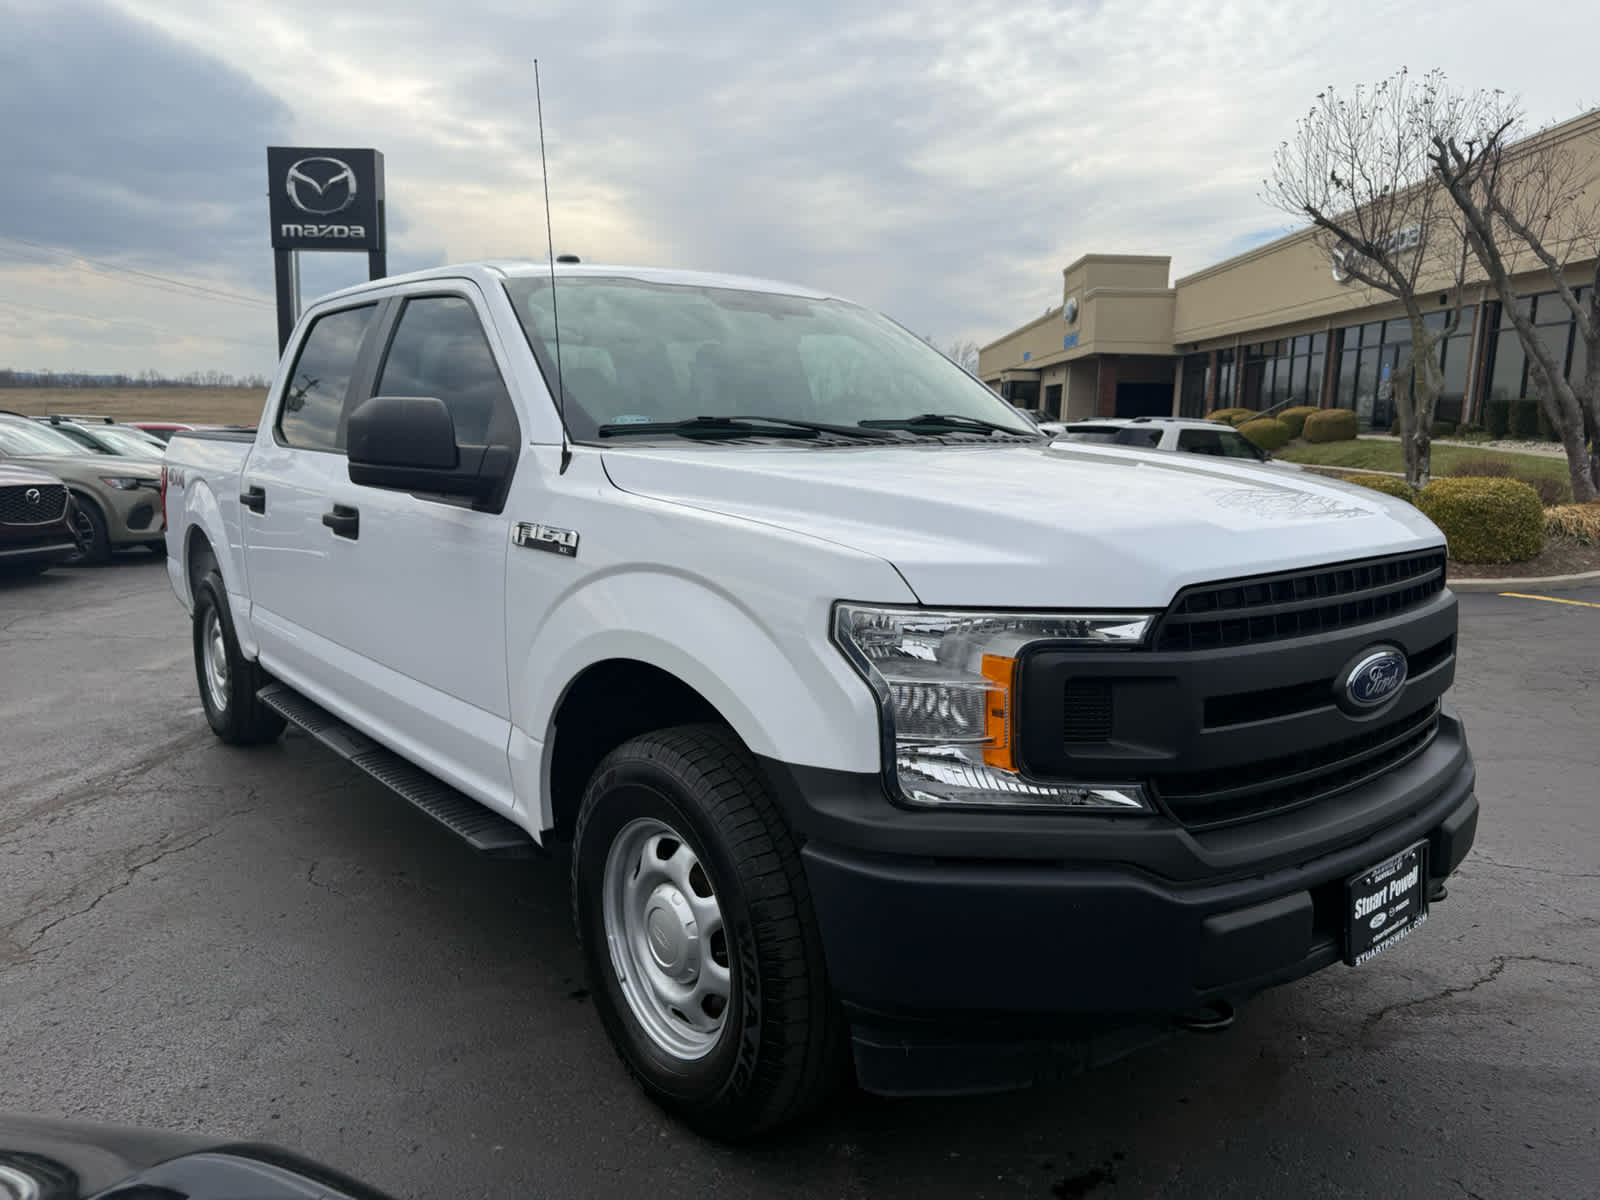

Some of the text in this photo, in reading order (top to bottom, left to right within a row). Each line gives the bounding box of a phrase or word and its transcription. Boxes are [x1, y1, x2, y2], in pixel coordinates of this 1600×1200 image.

[1366, 661, 1398, 696] Ford
[1355, 865, 1419, 920] Stuart Powell
[1355, 912, 1428, 966] STUARTPOWELL.COM
